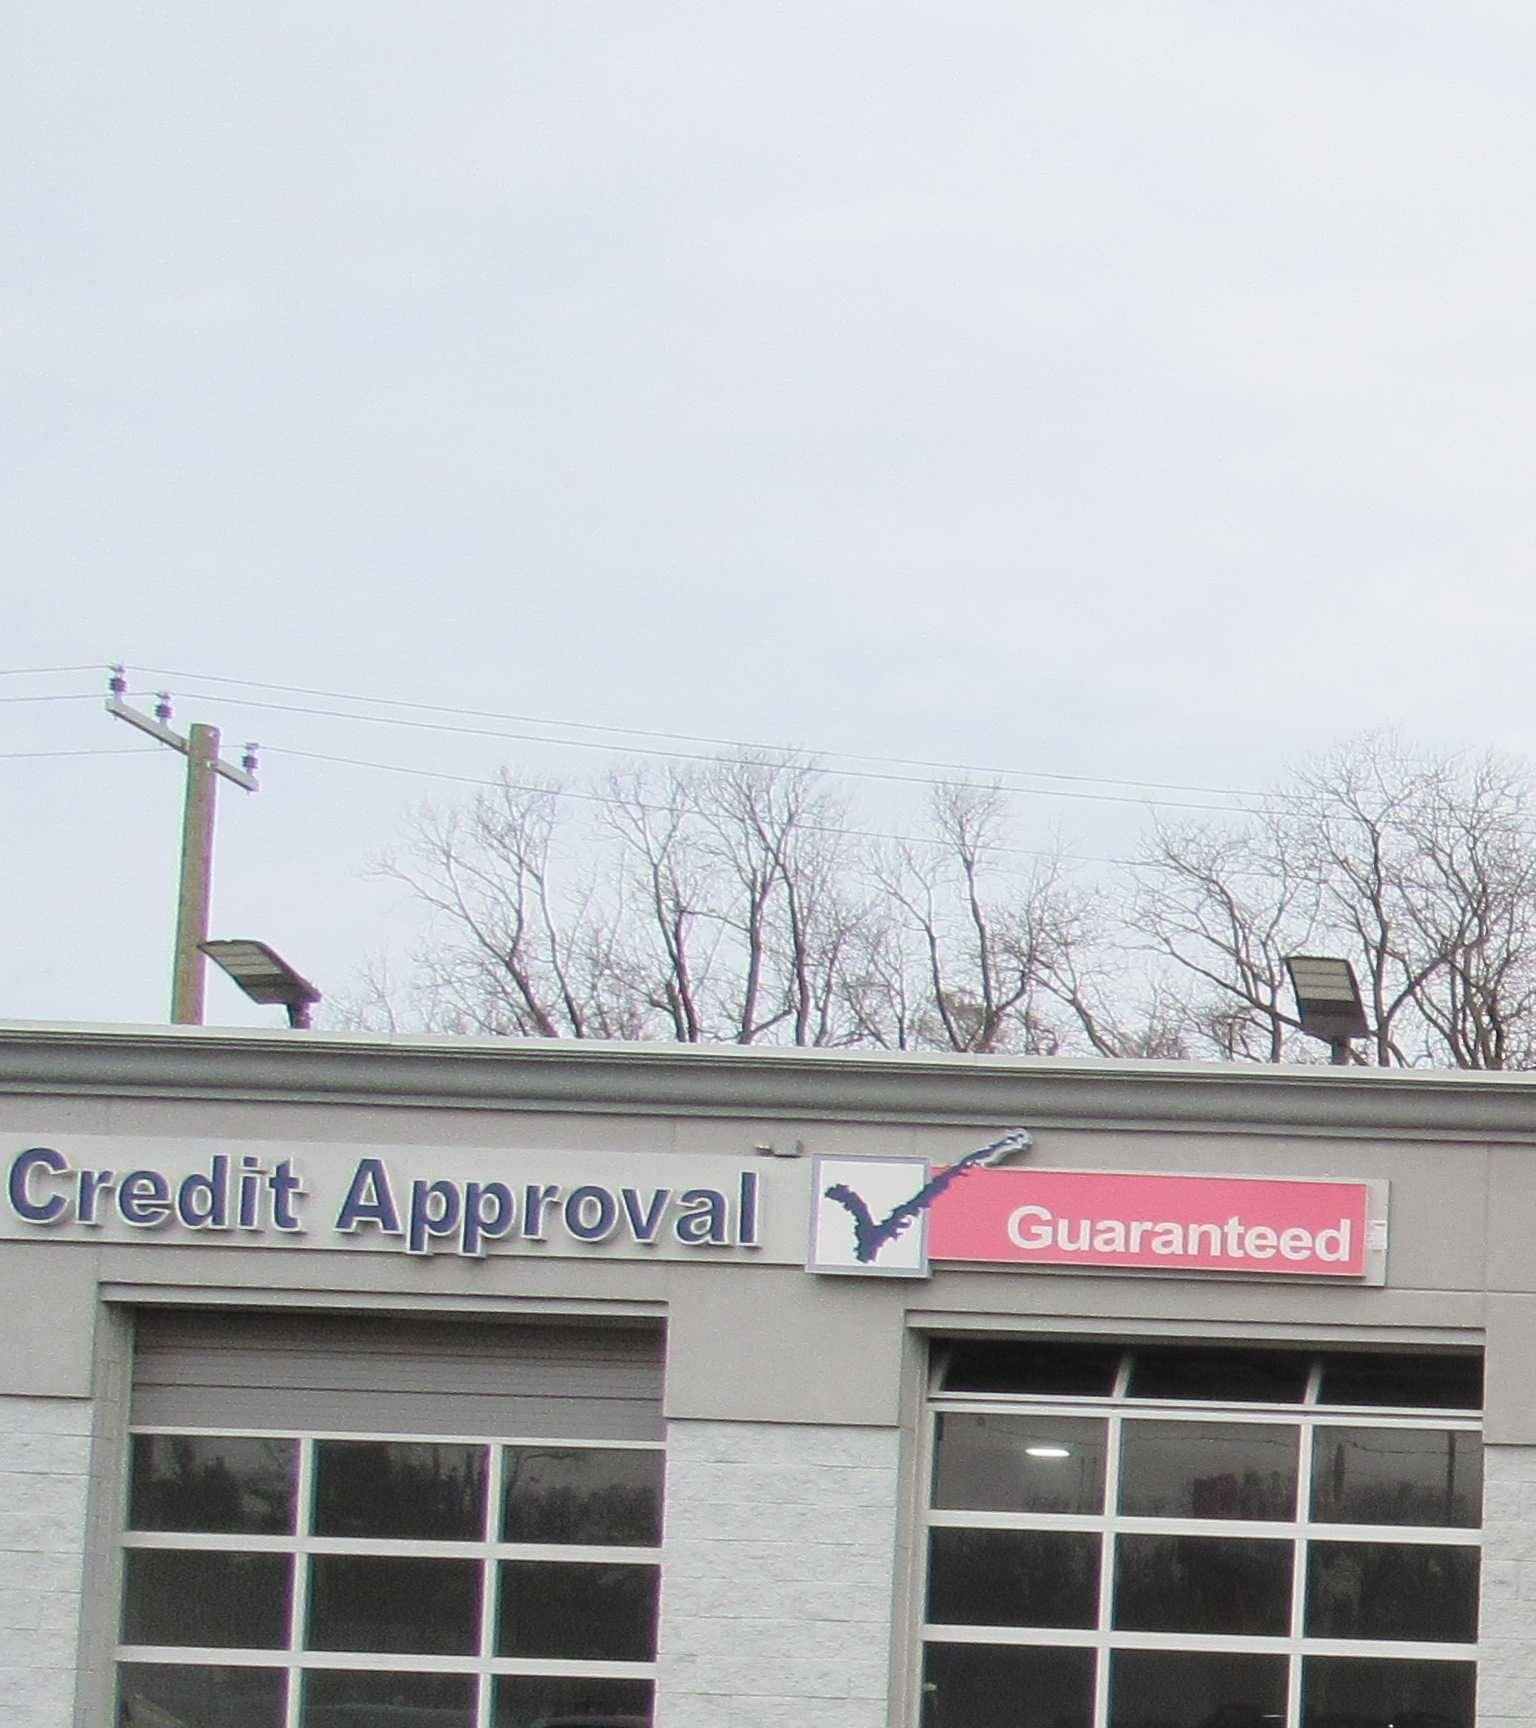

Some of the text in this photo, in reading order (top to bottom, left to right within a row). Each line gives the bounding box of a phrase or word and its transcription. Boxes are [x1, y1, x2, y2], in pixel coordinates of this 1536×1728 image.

[6, 1146, 761, 1258] Credit Approval
[1007, 1203, 1351, 1263] Guaranteed
